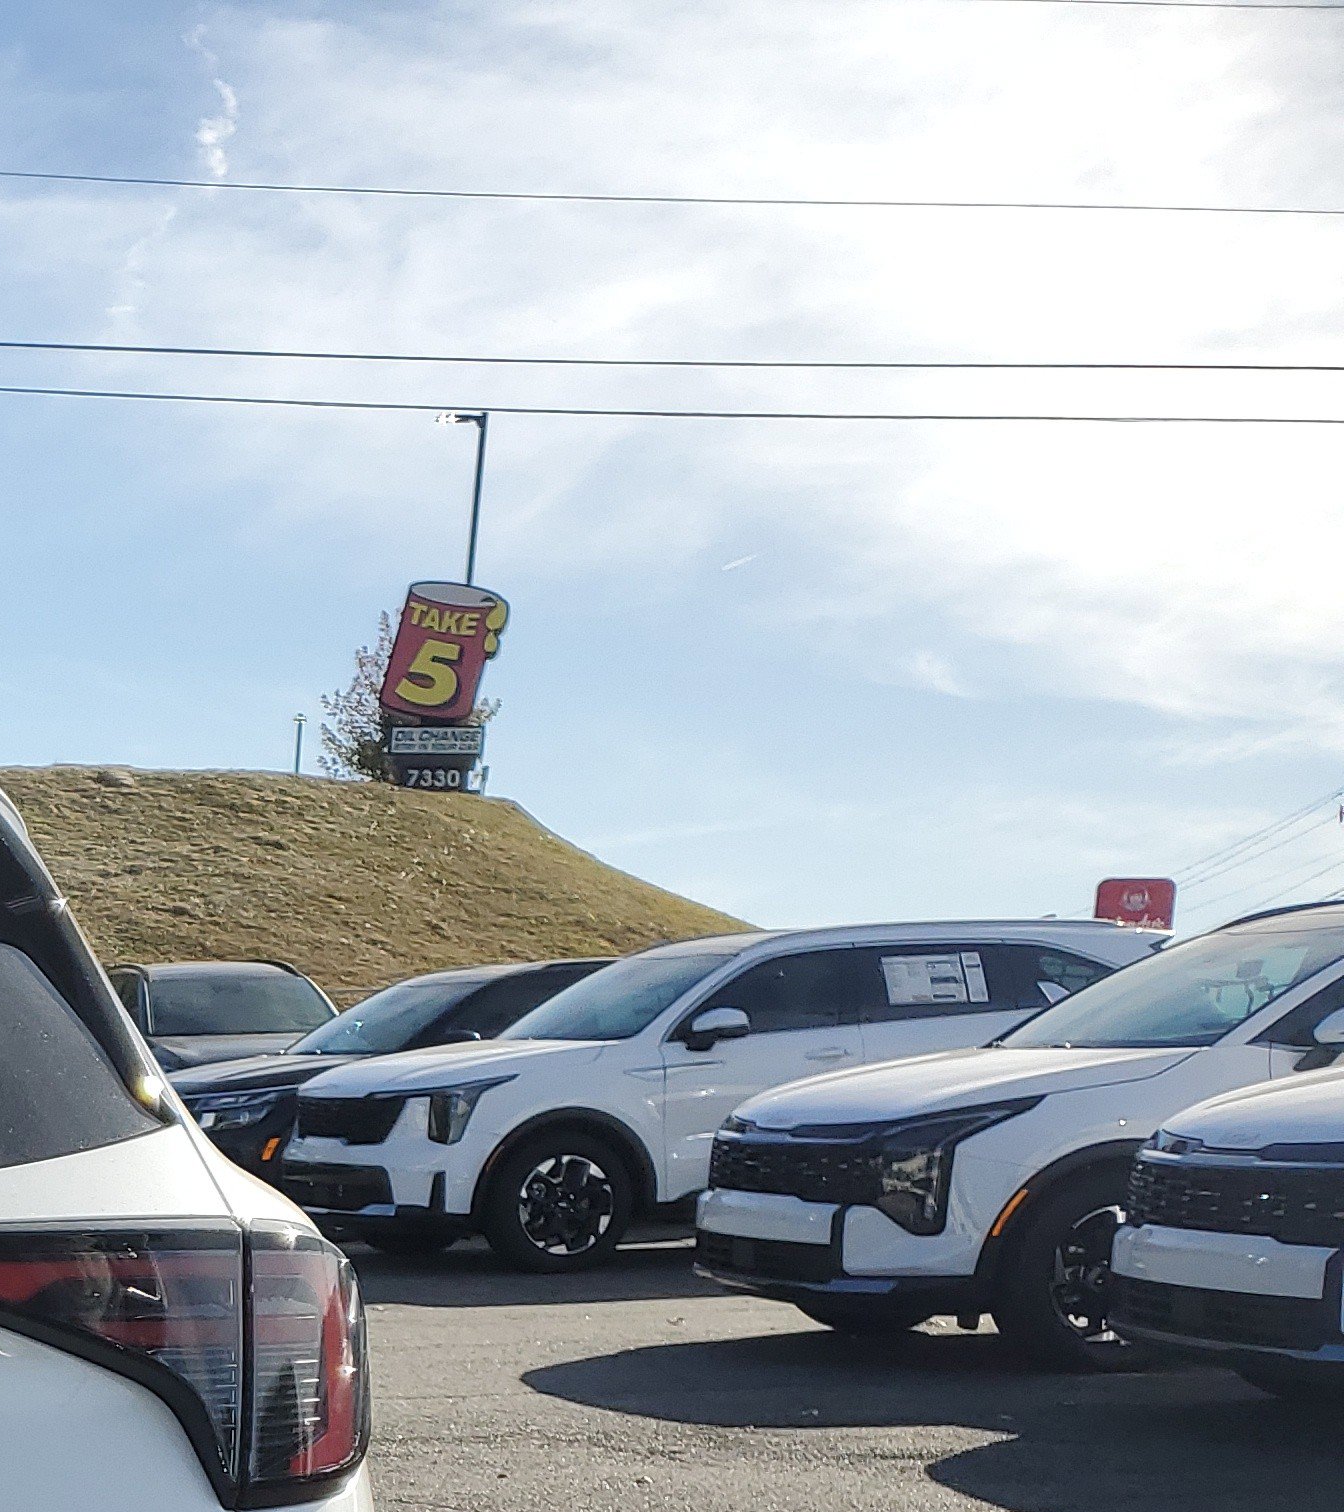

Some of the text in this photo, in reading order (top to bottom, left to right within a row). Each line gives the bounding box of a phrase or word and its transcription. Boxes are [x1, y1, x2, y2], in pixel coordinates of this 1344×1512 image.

[409, 602, 480, 636] TAKE
[395, 638, 461, 706] 5
[406, 769, 460, 787] 7330
